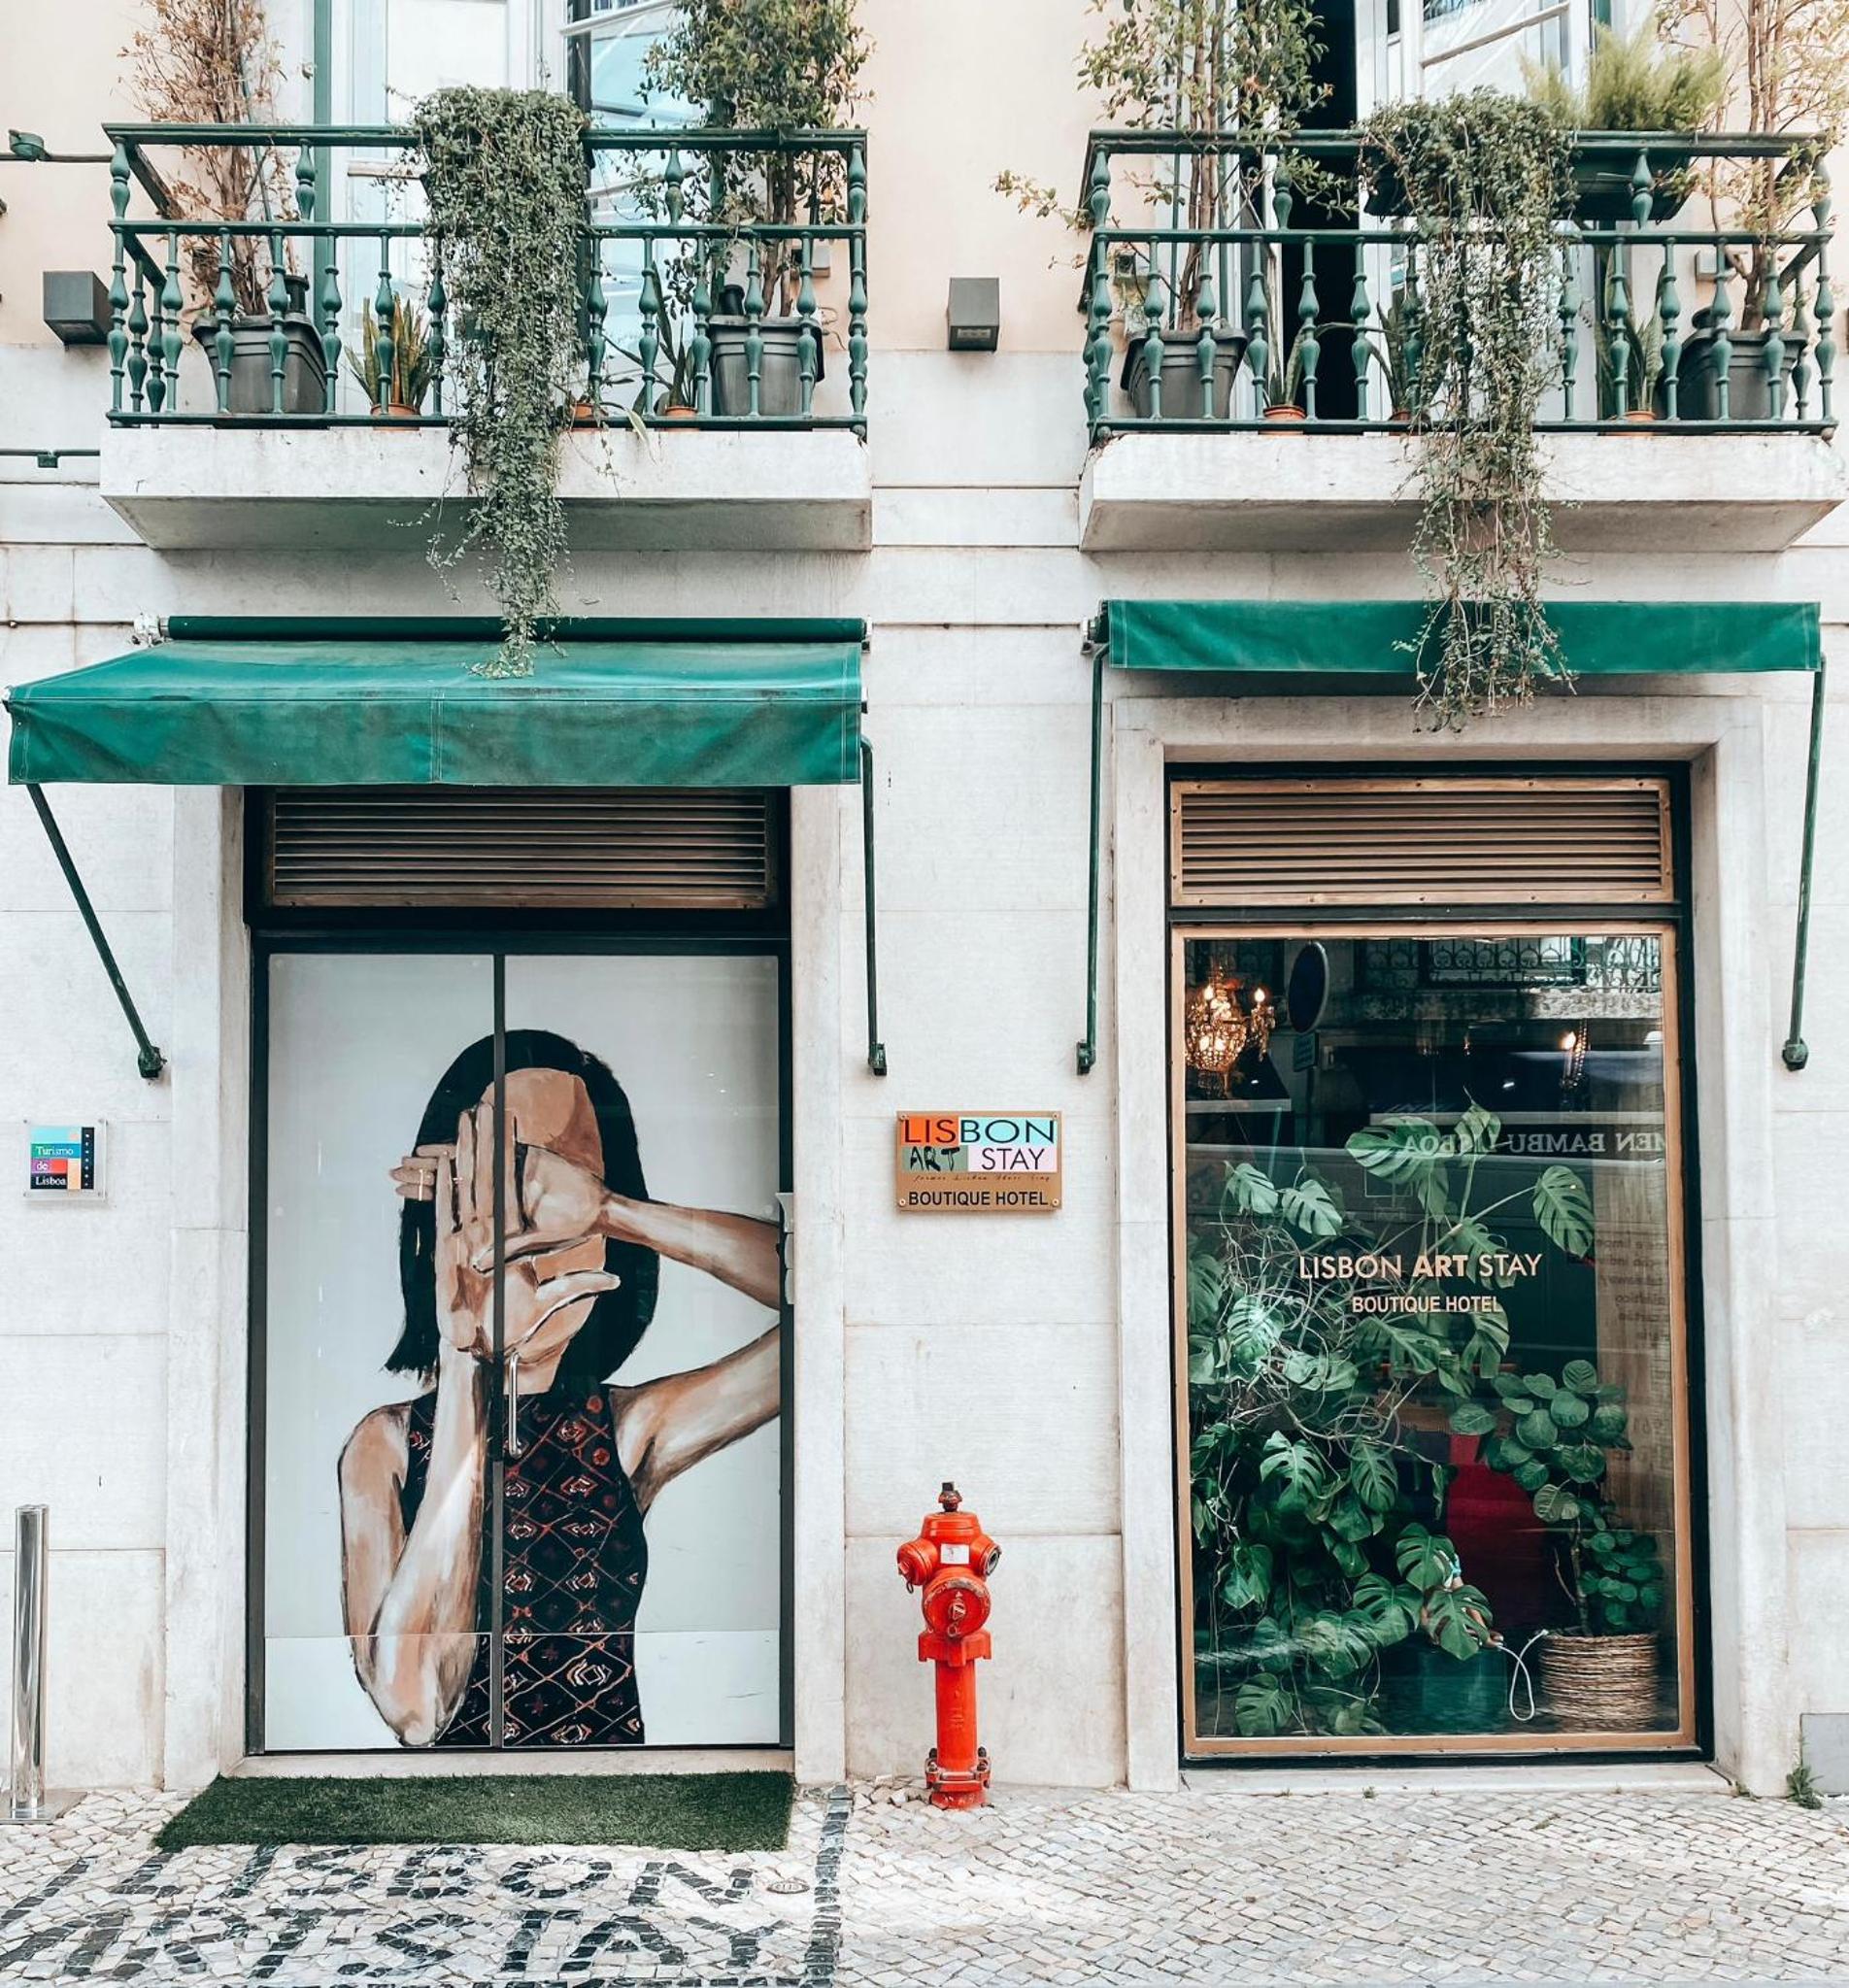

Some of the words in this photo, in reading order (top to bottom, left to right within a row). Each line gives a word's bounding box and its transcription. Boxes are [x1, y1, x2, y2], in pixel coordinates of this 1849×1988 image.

[904, 1119, 1055, 1143] LISBON
[35, 1145, 74, 1157] Turismo
[910, 1146, 960, 1172] ART
[981, 1147, 1046, 1170] STAY
[36, 1162, 50, 1171] de
[35, 1175, 66, 1186] Lisboa
[908, 1192, 991, 1206] BOUTIQUE
[995, 1192, 1049, 1205] HOTEL
[1299, 1254, 1402, 1279] LISBON
[1411, 1254, 1469, 1278] ART
[1478, 1253, 1543, 1277] STAY
[1352, 1296, 1441, 1314] BOUTIQUE
[1445, 1296, 1502, 1313] HOTEL
